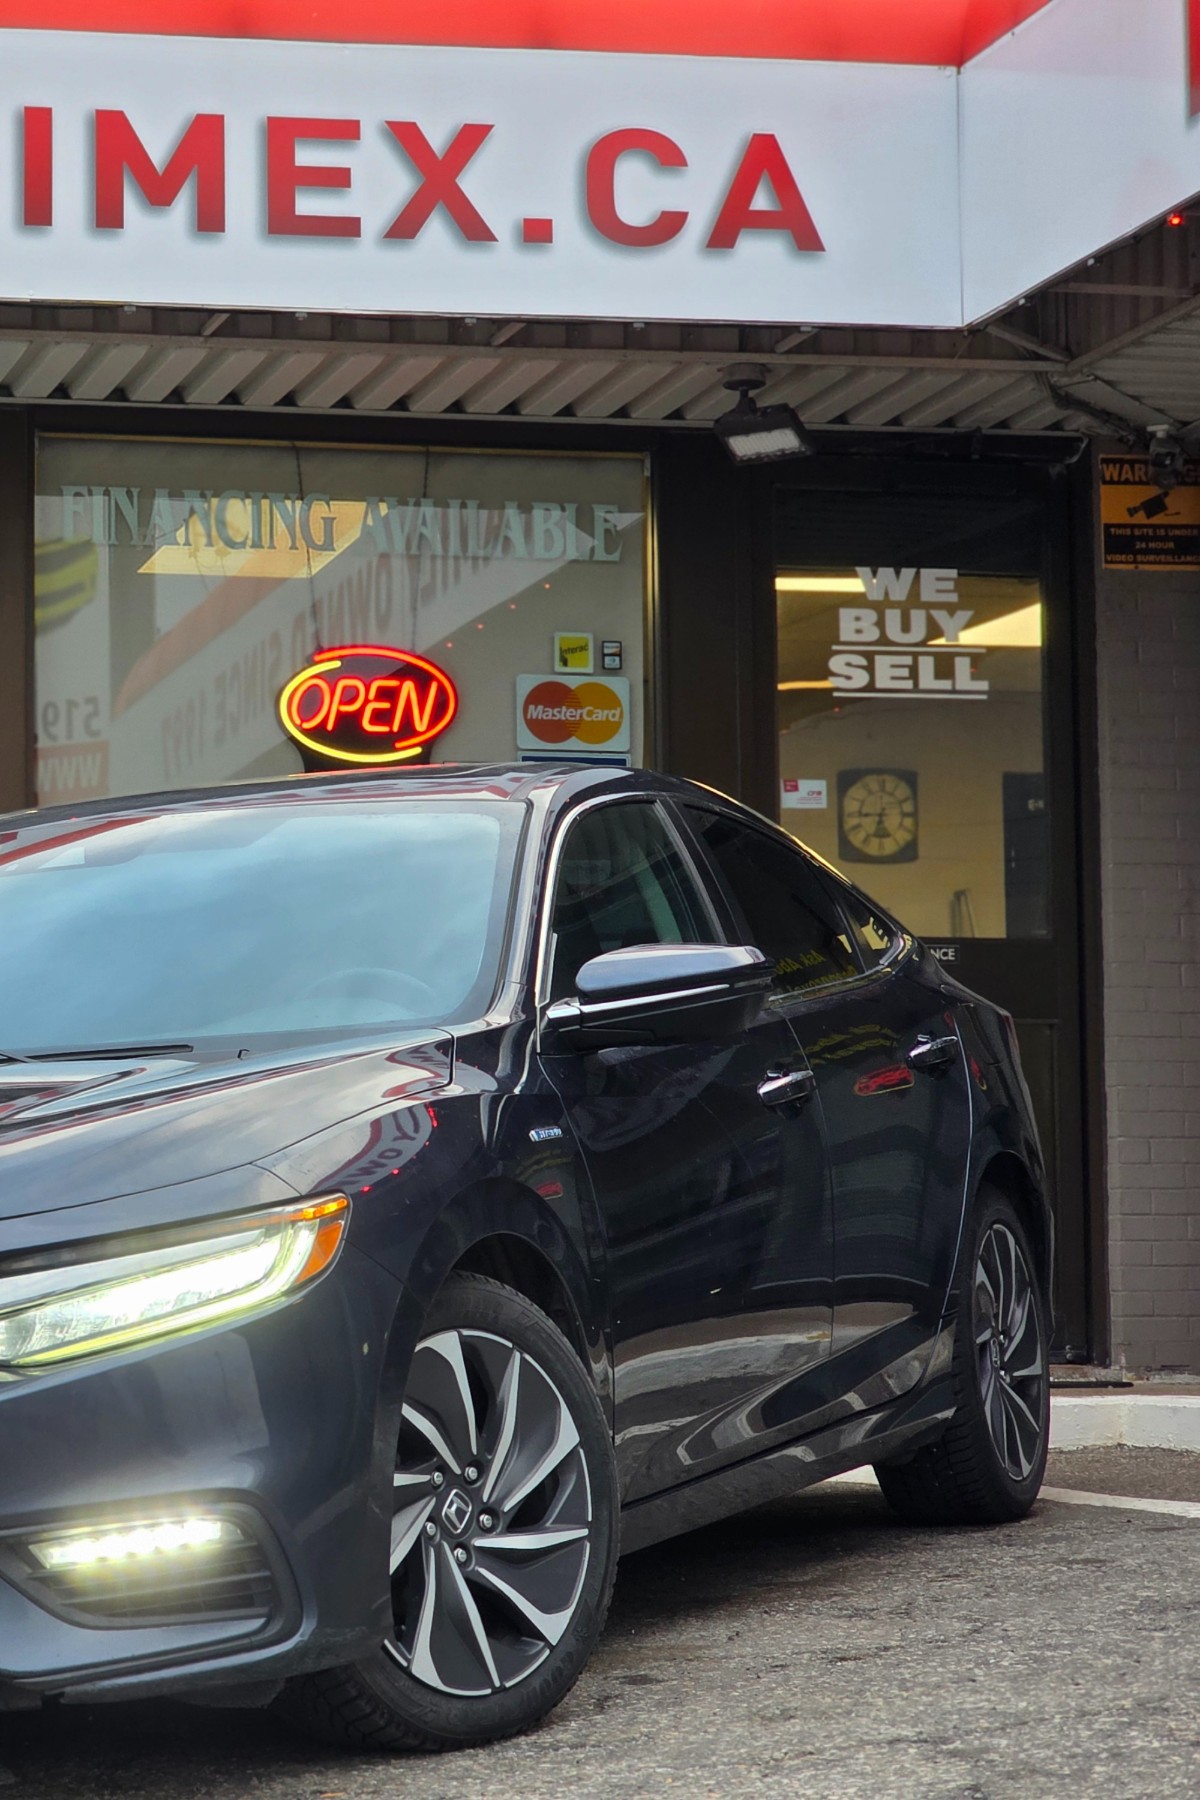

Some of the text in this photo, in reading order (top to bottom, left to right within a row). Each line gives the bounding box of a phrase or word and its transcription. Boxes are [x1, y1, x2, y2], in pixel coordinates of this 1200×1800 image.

[1102, 463, 1199, 483] WARG
[61, 485, 336, 552] FINANCING
[358, 496, 623, 562] AVAILABLE
[1111, 528, 1131, 536] THIS
[1148, 541, 1175, 549] HOUR
[855, 566, 958, 602] WE
[839, 608, 975, 644] BUY
[828, 654, 989, 690] SELL
[291, 678, 438, 732] OPEN
[527, 705, 621, 722] MasterCard
